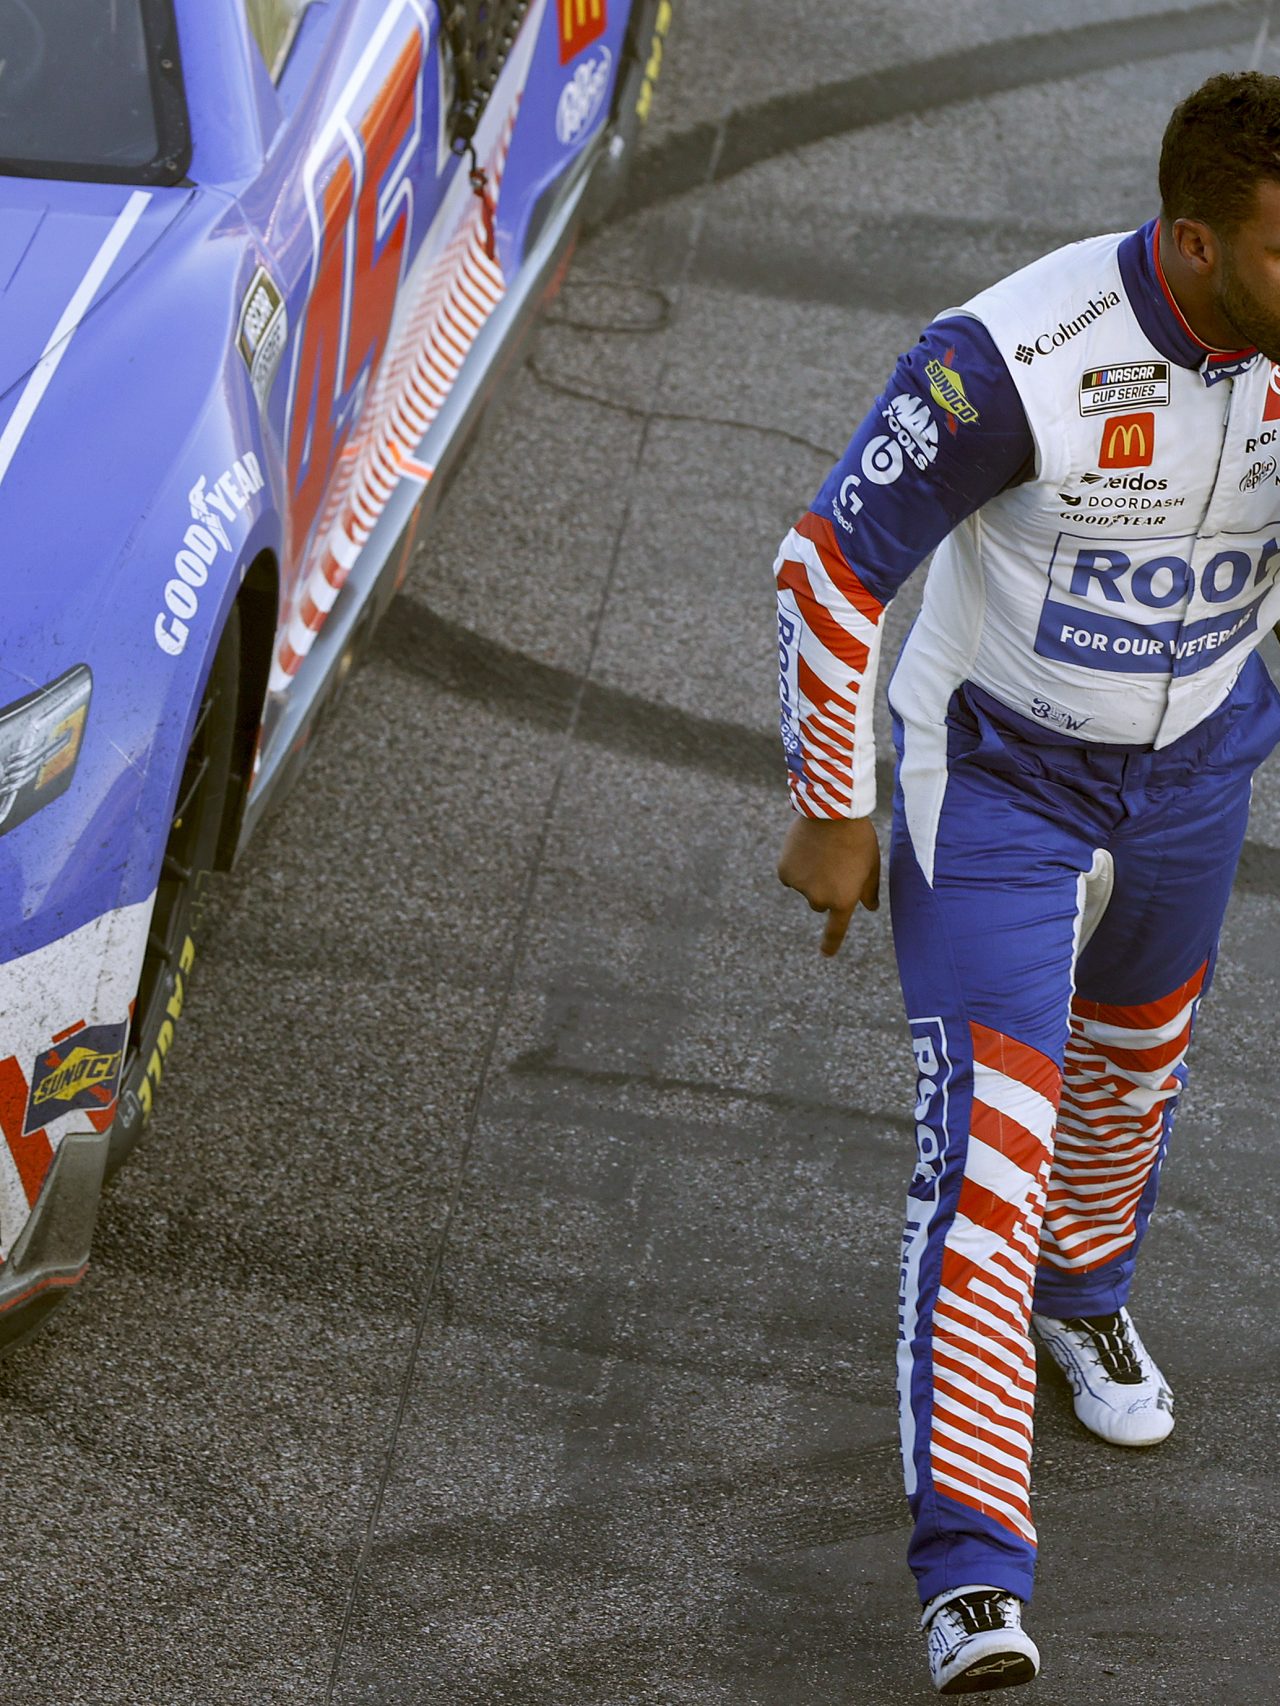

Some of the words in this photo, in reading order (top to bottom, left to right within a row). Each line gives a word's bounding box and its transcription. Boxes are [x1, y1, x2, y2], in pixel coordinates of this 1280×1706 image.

[1034, 290, 1121, 355] Columbia
[927, 361, 977, 421] SUNOCO
[1092, 389, 1116, 404] CUP
[1117, 384, 1156, 400] SERIES
[1105, 366, 1156, 385] NASCAR
[881, 404, 929, 471] TOOLS
[890, 393, 939, 463] MAC
[1060, 512, 1166, 527] GOODYEAR
[1088, 497, 1185, 510] DOORDASH
[154, 451, 265, 656] GOODYEAR
[1060, 624, 1107, 651] FOR
[1112, 636, 1164, 656] OUR
